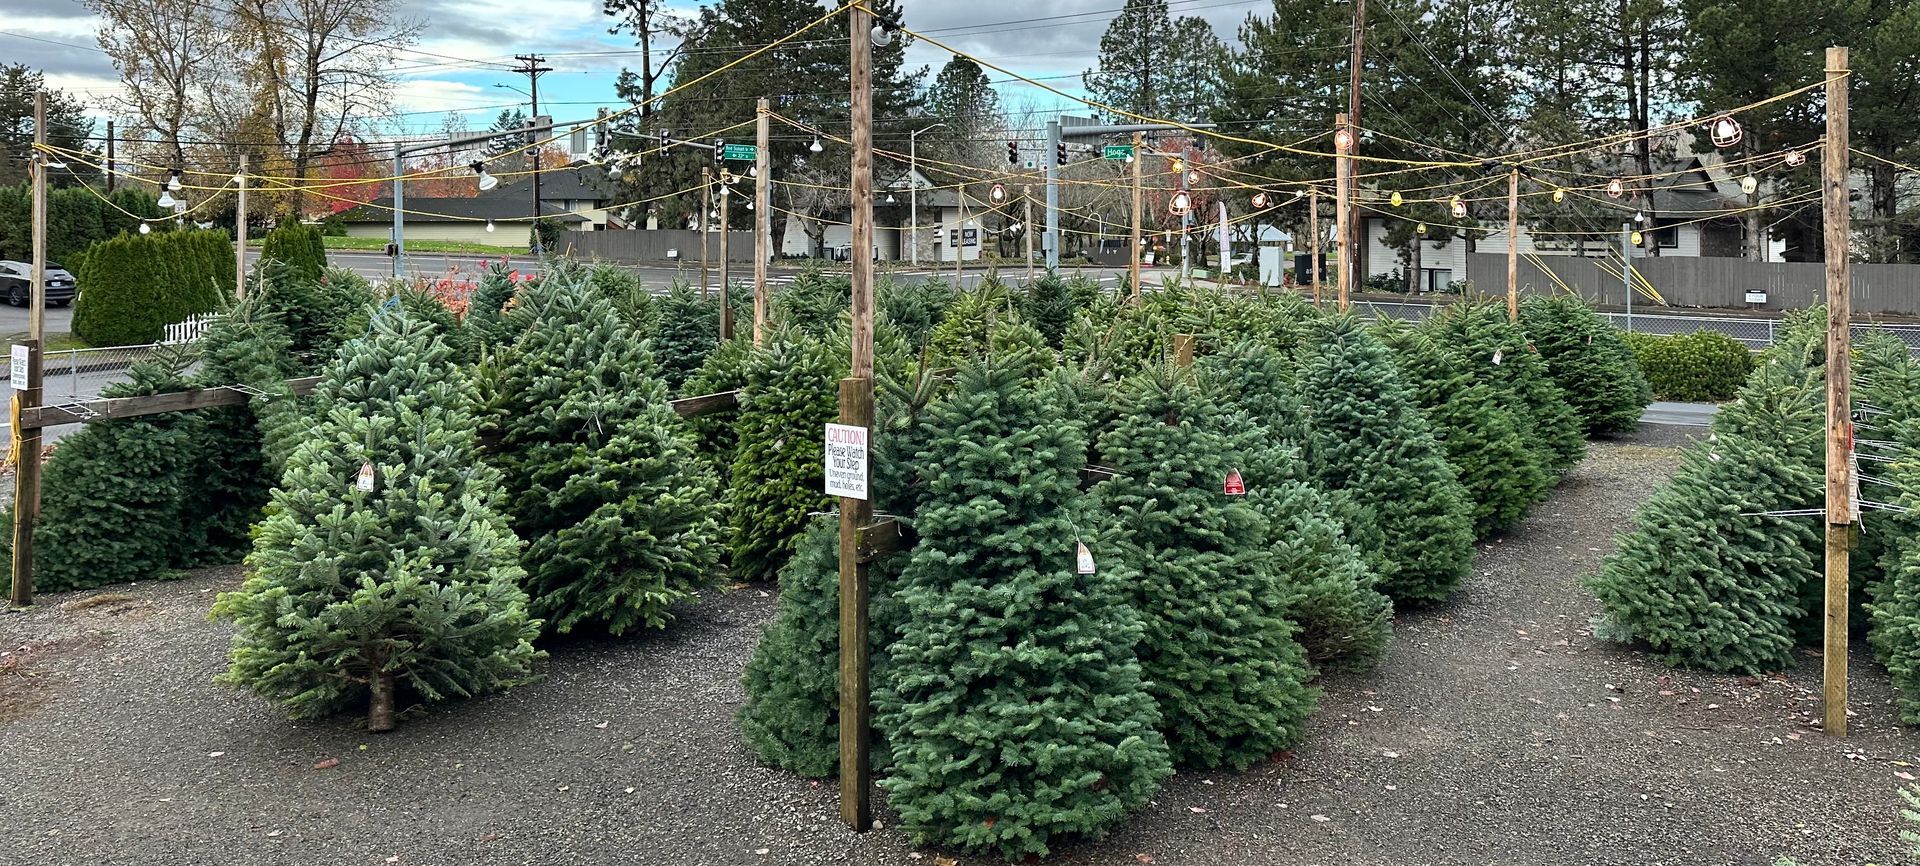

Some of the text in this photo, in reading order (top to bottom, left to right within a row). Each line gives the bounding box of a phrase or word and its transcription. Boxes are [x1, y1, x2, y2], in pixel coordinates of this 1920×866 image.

[828, 427, 864, 446] CAUTION!
[828, 443, 864, 459] Please Watch
[833, 456, 860, 473] Your Step
[829, 469, 846, 479] Uneven
